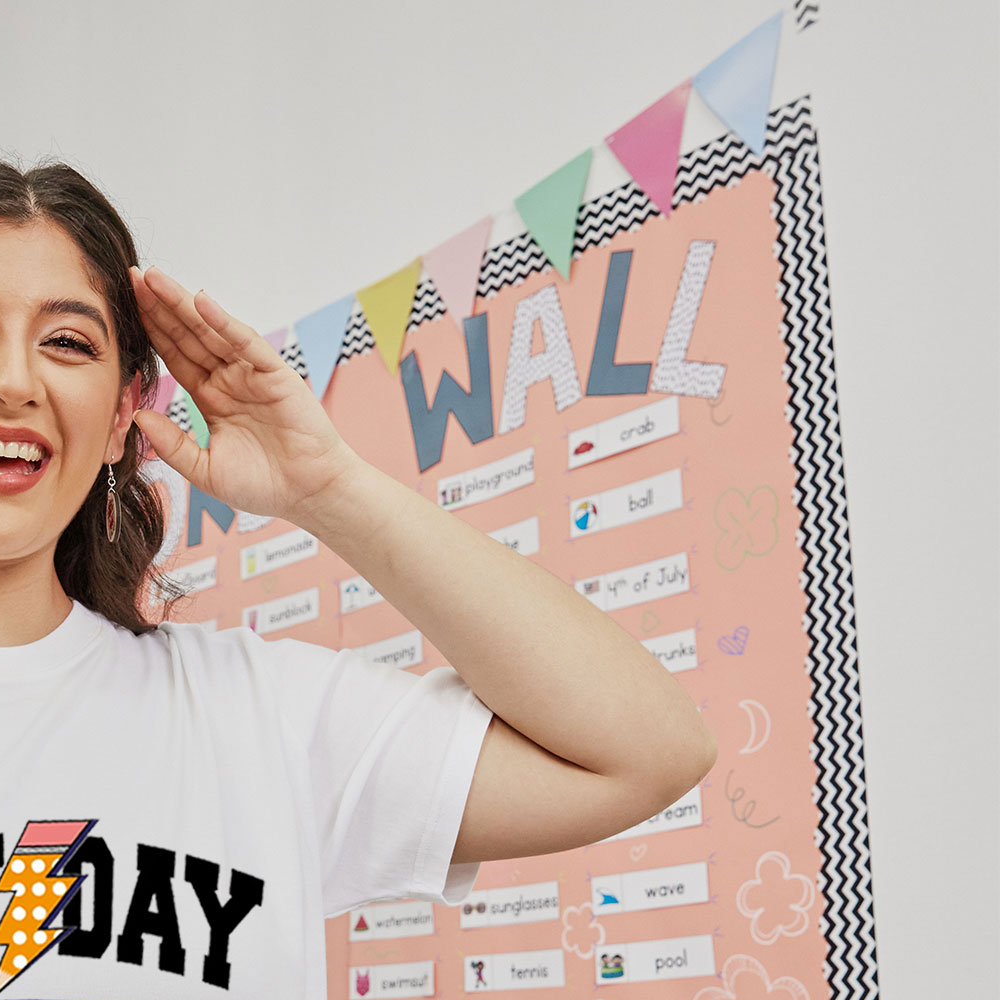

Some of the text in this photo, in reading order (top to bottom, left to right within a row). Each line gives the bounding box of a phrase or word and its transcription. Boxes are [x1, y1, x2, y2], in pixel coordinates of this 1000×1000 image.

[404, 240, 727, 473] WALL
[620, 417, 655, 442] crab
[465, 453, 535, 496] playground
[629, 489, 654, 513] ball
[633, 572, 650, 593] of
[656, 563, 688, 588] July
[645, 881, 685, 899] wave
[58, 835, 265, 990] DAY
[490, 894, 558, 917] sunglasses
[376, 911, 432, 929] watermelon
[511, 967, 548, 980] tennis
[655, 948, 687, 974] pool
